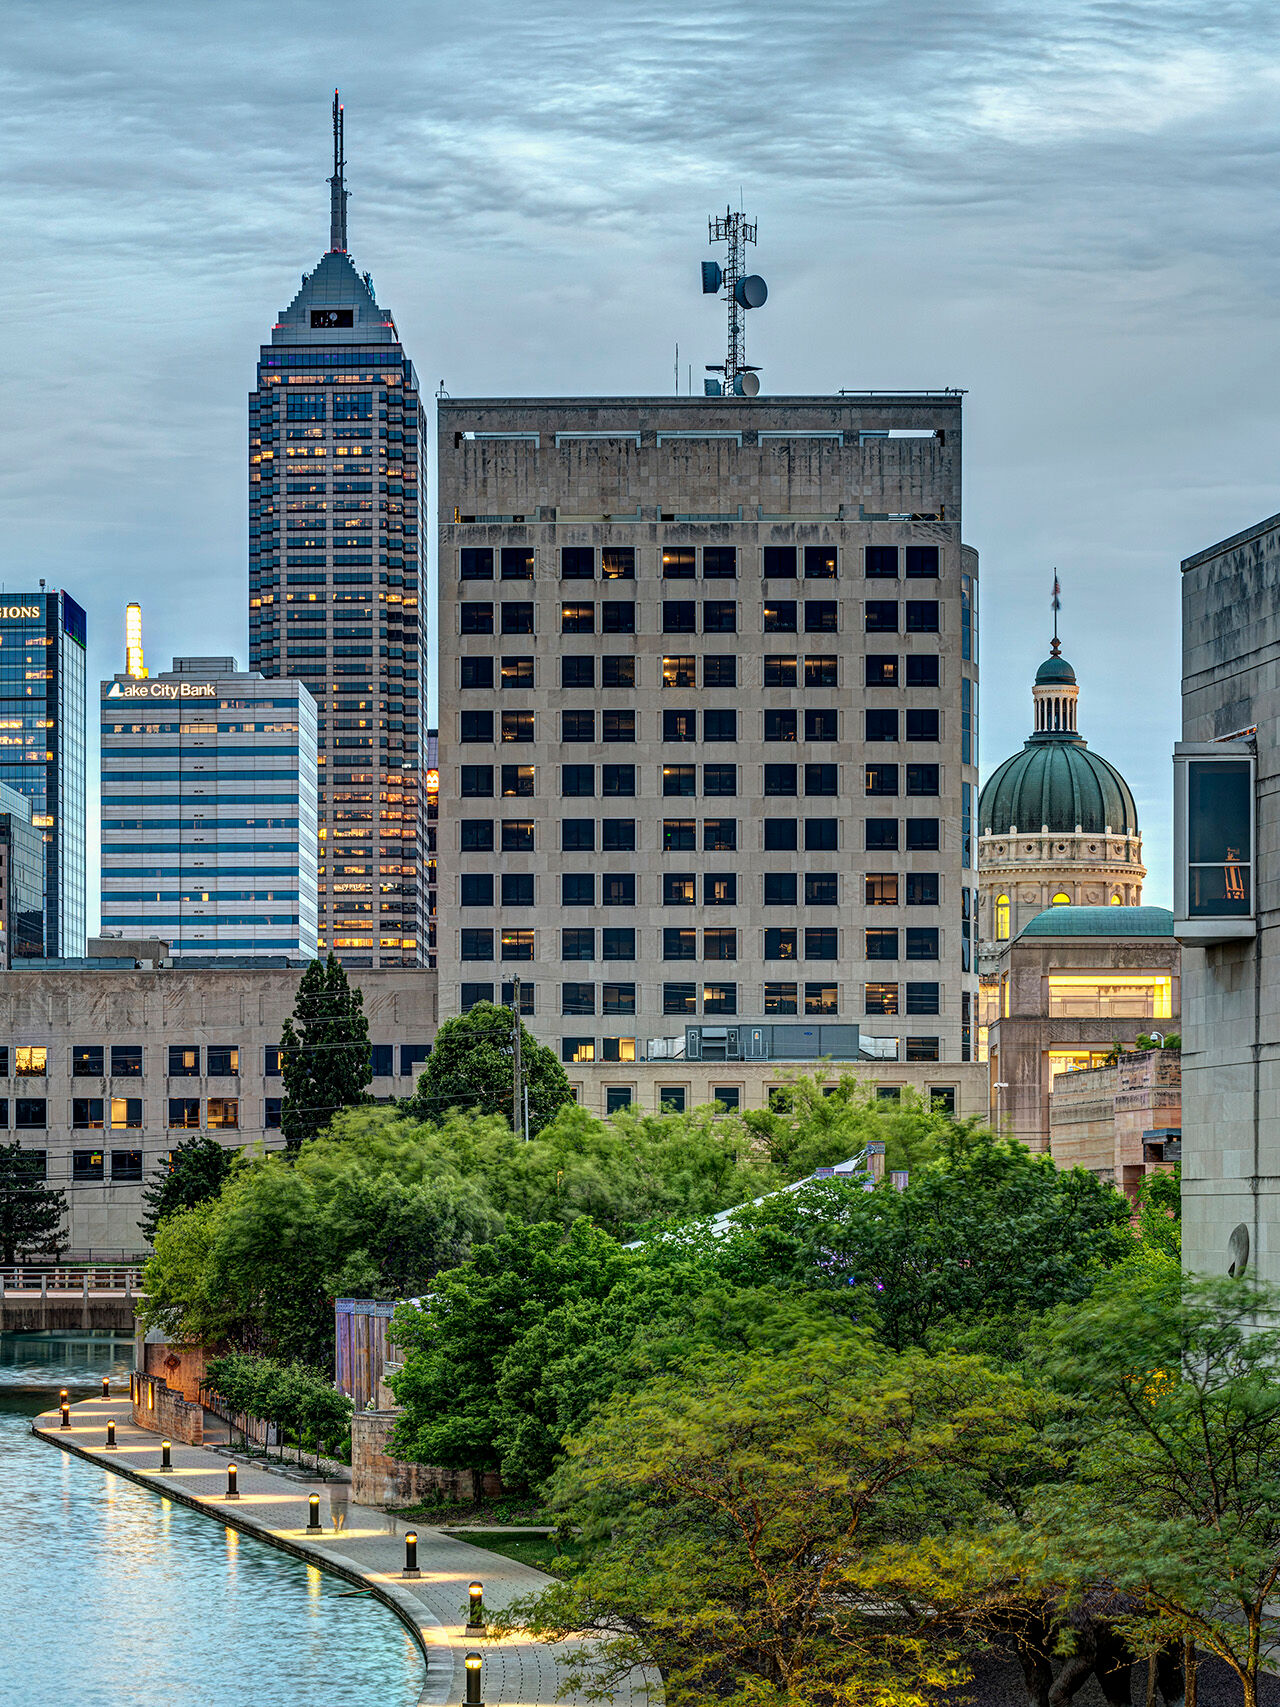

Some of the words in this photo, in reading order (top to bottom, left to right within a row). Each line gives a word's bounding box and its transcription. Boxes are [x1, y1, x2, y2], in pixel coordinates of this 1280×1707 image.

[107, 682, 148, 697] Lake
[150, 683, 178, 699] City
[180, 683, 216, 696] Bank
